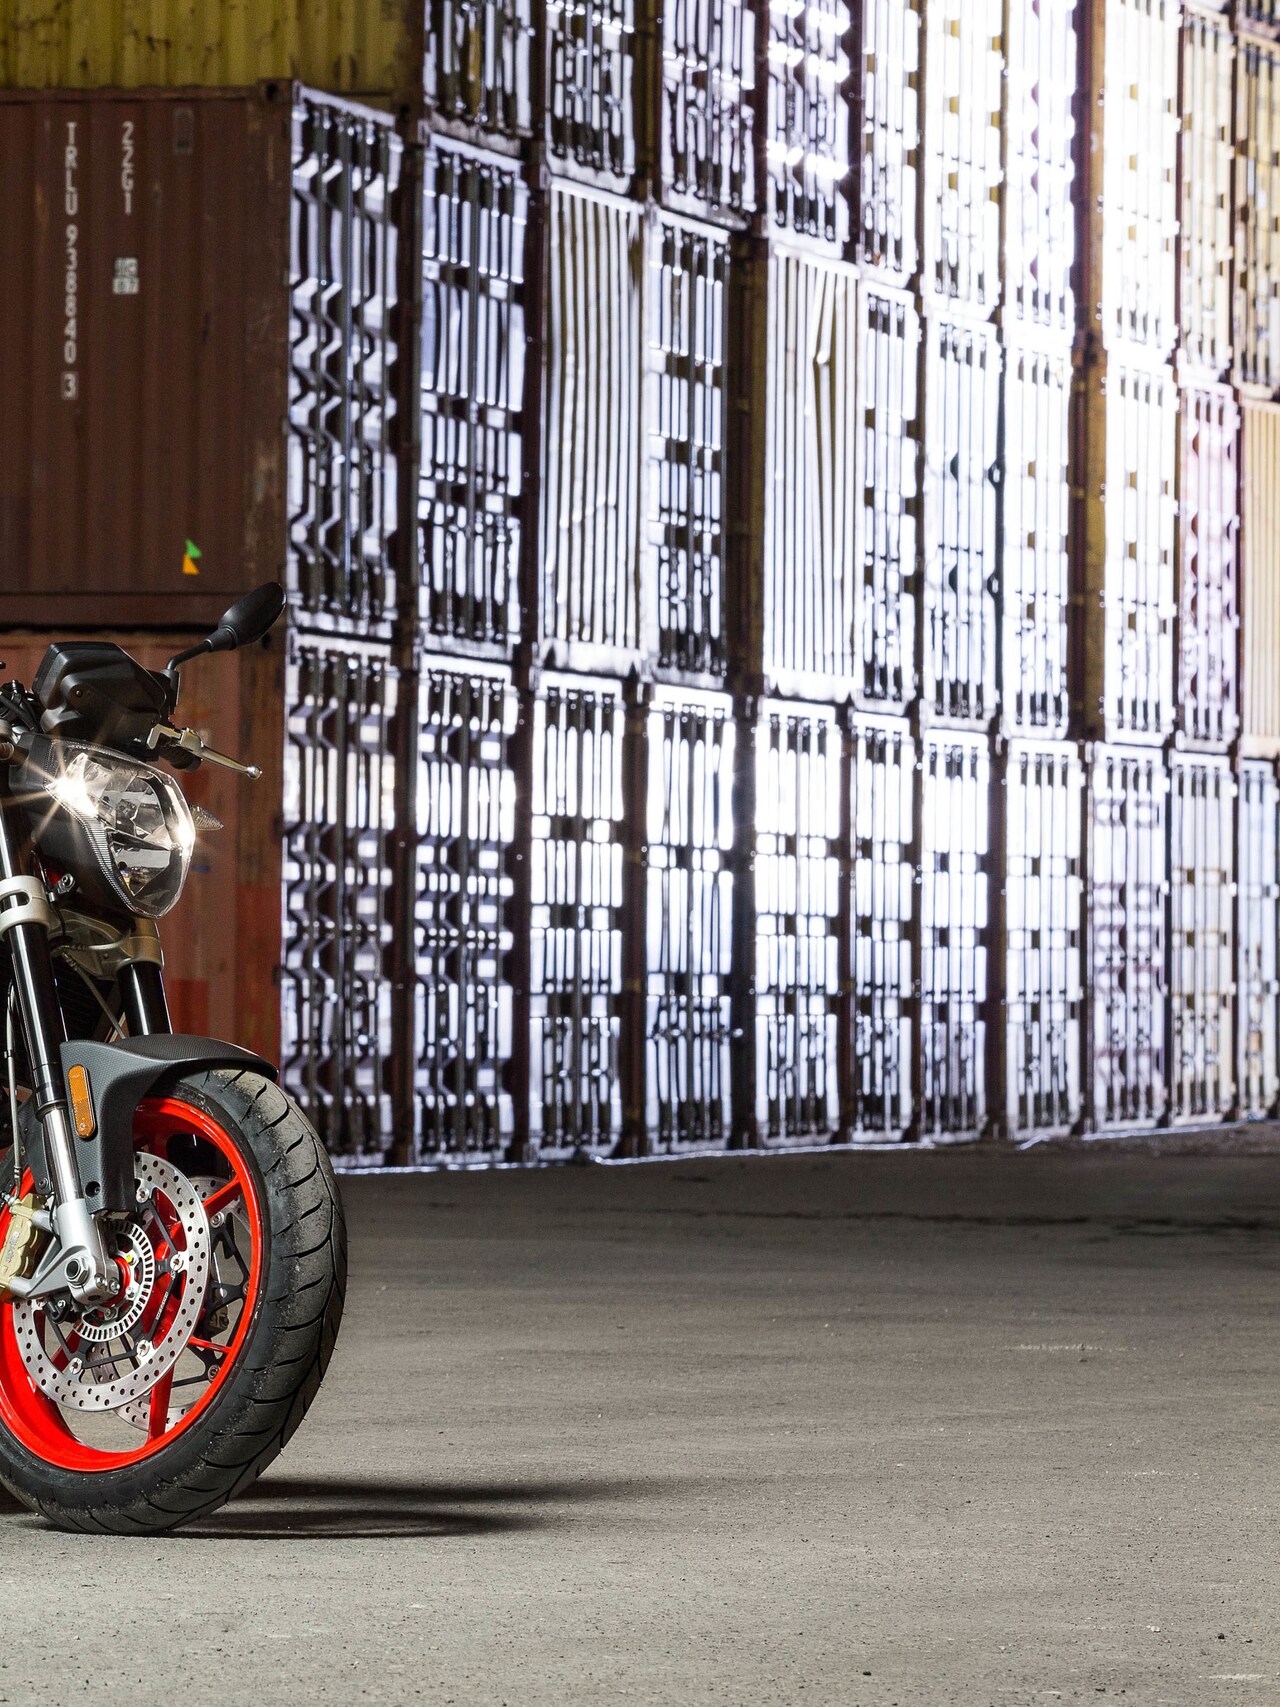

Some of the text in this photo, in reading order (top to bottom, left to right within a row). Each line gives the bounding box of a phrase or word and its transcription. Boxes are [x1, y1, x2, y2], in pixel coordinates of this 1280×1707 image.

[63, 121, 78, 398] TRLU 938840 3
[121, 120, 135, 215] 22G1
